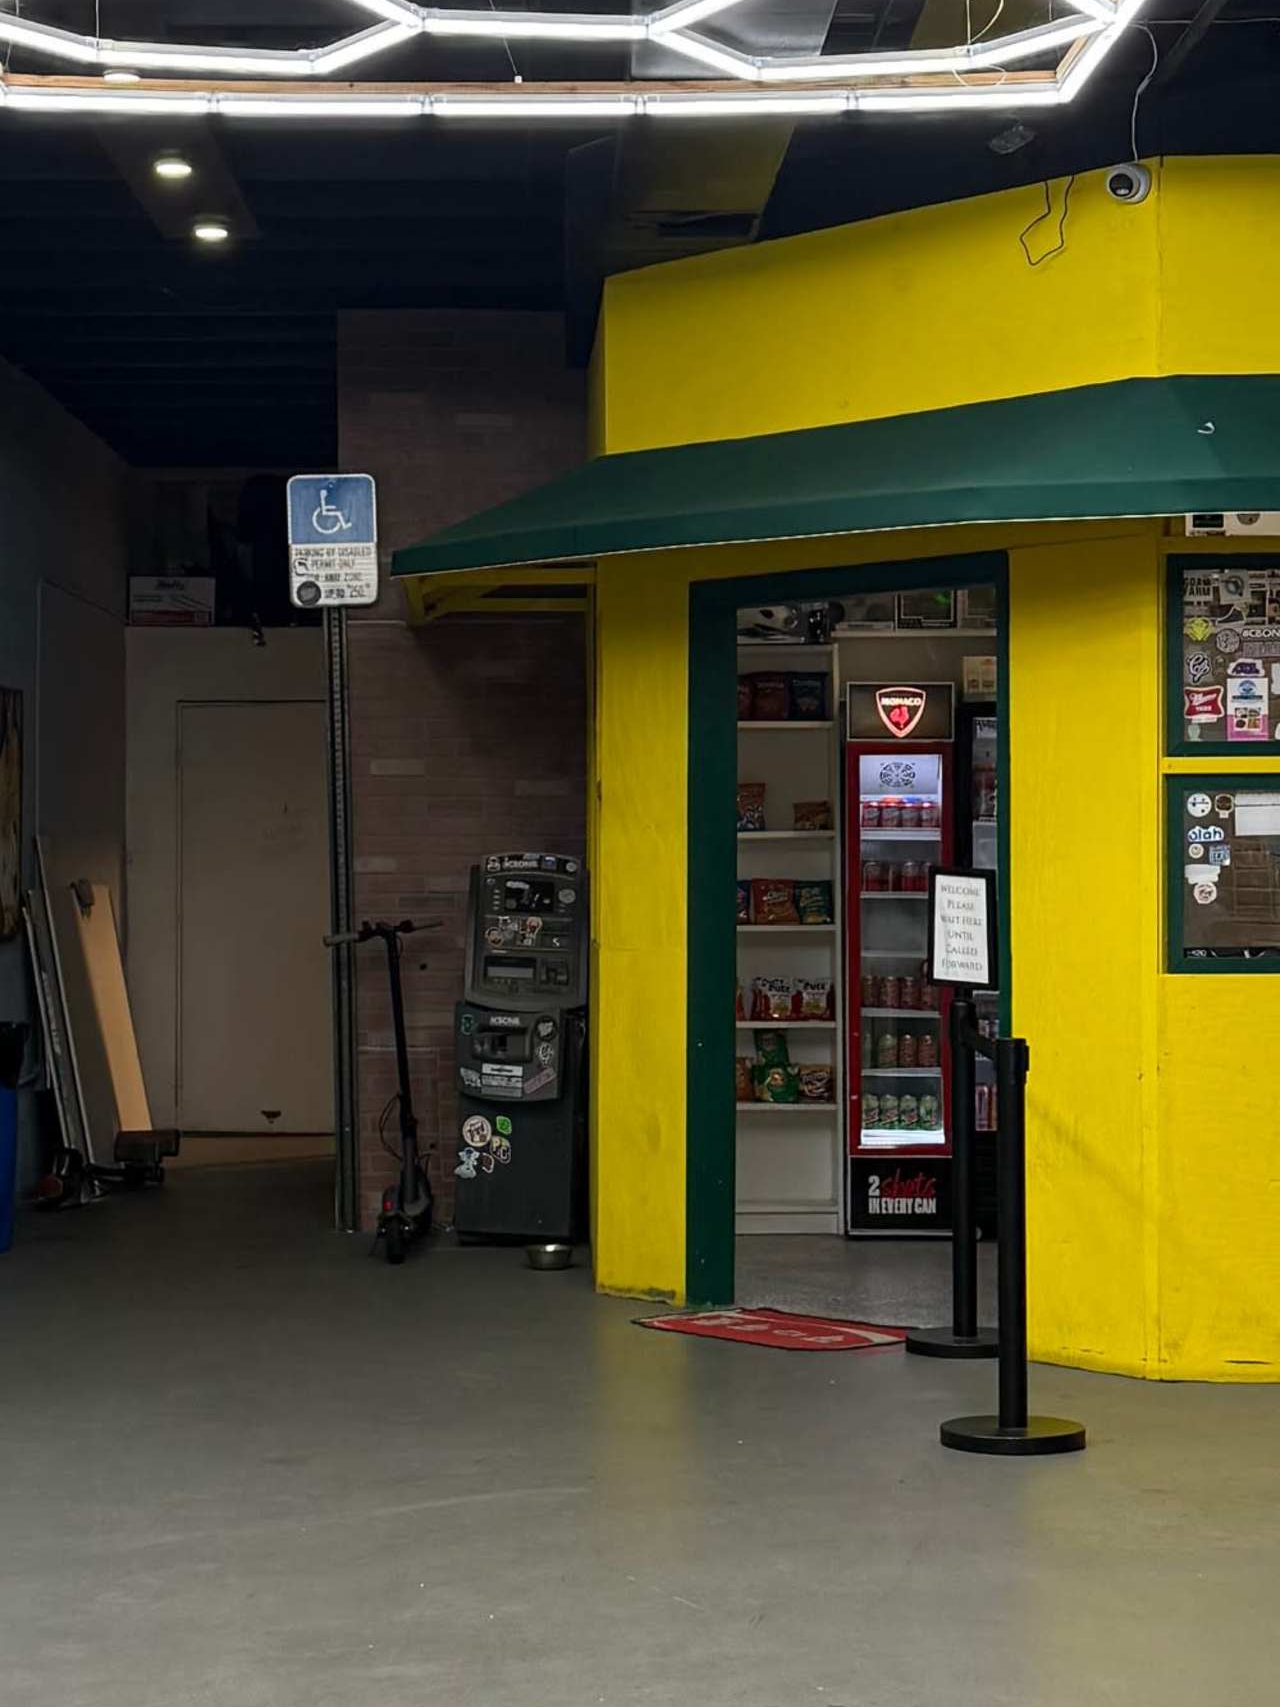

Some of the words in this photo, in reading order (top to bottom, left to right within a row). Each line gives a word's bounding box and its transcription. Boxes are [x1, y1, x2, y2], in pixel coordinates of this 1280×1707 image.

[880, 696, 922, 706] MONACO
[940, 884, 981, 896] WELCOME
[946, 899, 977, 911] PLEASE
[947, 929, 974, 942] UNTIL
[867, 1175, 881, 1197] 2
[880, 1167, 937, 1198] shots
[868, 1197, 880, 1214] IN
[881, 1197, 914, 1214] EVERY
[914, 1197, 937, 1214] CAN
